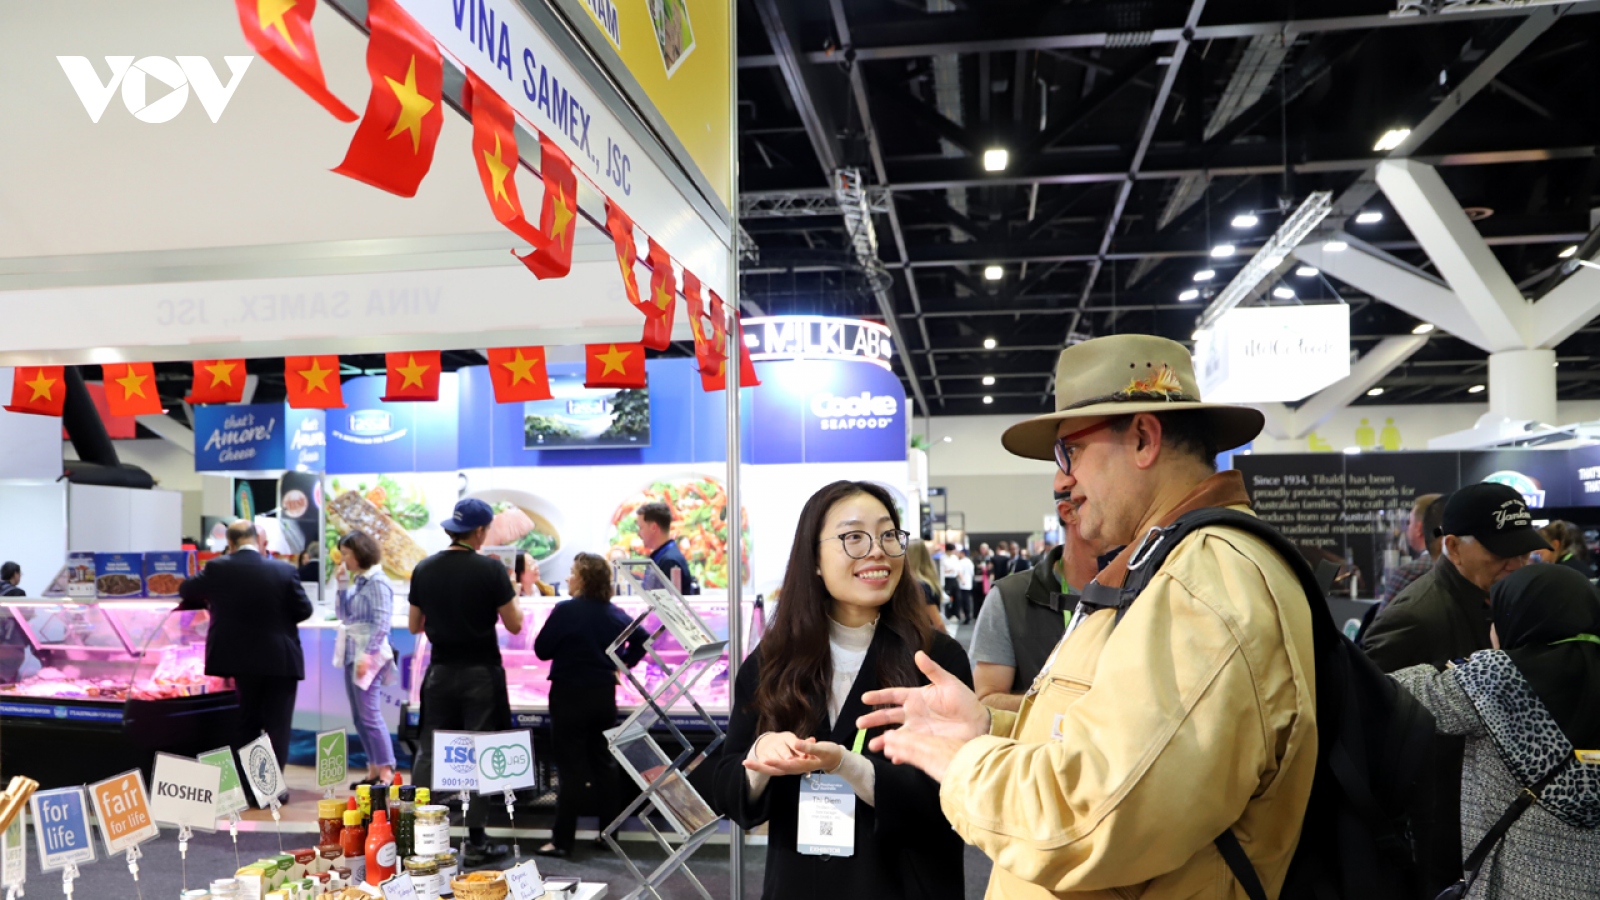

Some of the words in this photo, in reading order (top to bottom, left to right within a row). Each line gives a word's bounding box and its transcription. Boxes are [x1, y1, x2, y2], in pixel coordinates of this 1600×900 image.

[452, 0, 513, 82] VINA
[605, 136, 632, 197] JSC
[810, 391, 898, 418] Cooke
[204, 418, 276, 451] Amore!
[1252, 475, 1280, 486] Since
[1283, 475, 1310, 487] 1934,
[1350, 474, 1367, 484] has
[1369, 474, 1395, 484] been
[1253, 487, 1291, 500] proudly
[1292, 487, 1342, 499] producing
[1344, 486, 1399, 498] smallgoods
[1401, 486, 1415, 496] for
[1254, 500, 1300, 510] Australian
[1302, 499, 1340, 510] families.
[1344, 499, 1361, 509] We
[1363, 499, 1385, 509] craft
[1387, 498, 1398, 508] all
[1296, 511, 1318, 522] from
[1320, 513, 1337, 522] our
[1282, 523, 1330, 534] traditional
[1332, 523, 1374, 534] methods
[516, 714, 543, 723] Cooke
[320, 754, 343, 770] BRC
[506, 754, 526, 766] JAS
[320, 765, 343, 781] FOOD
[442, 776, 479, 786] 9001:201
[102, 779, 138, 818] fair
[157, 781, 213, 804] KOSHER
[42, 800, 69, 823] for
[110, 820, 127, 835] for
[127, 810, 146, 828] life
[46, 824, 76, 850] life
